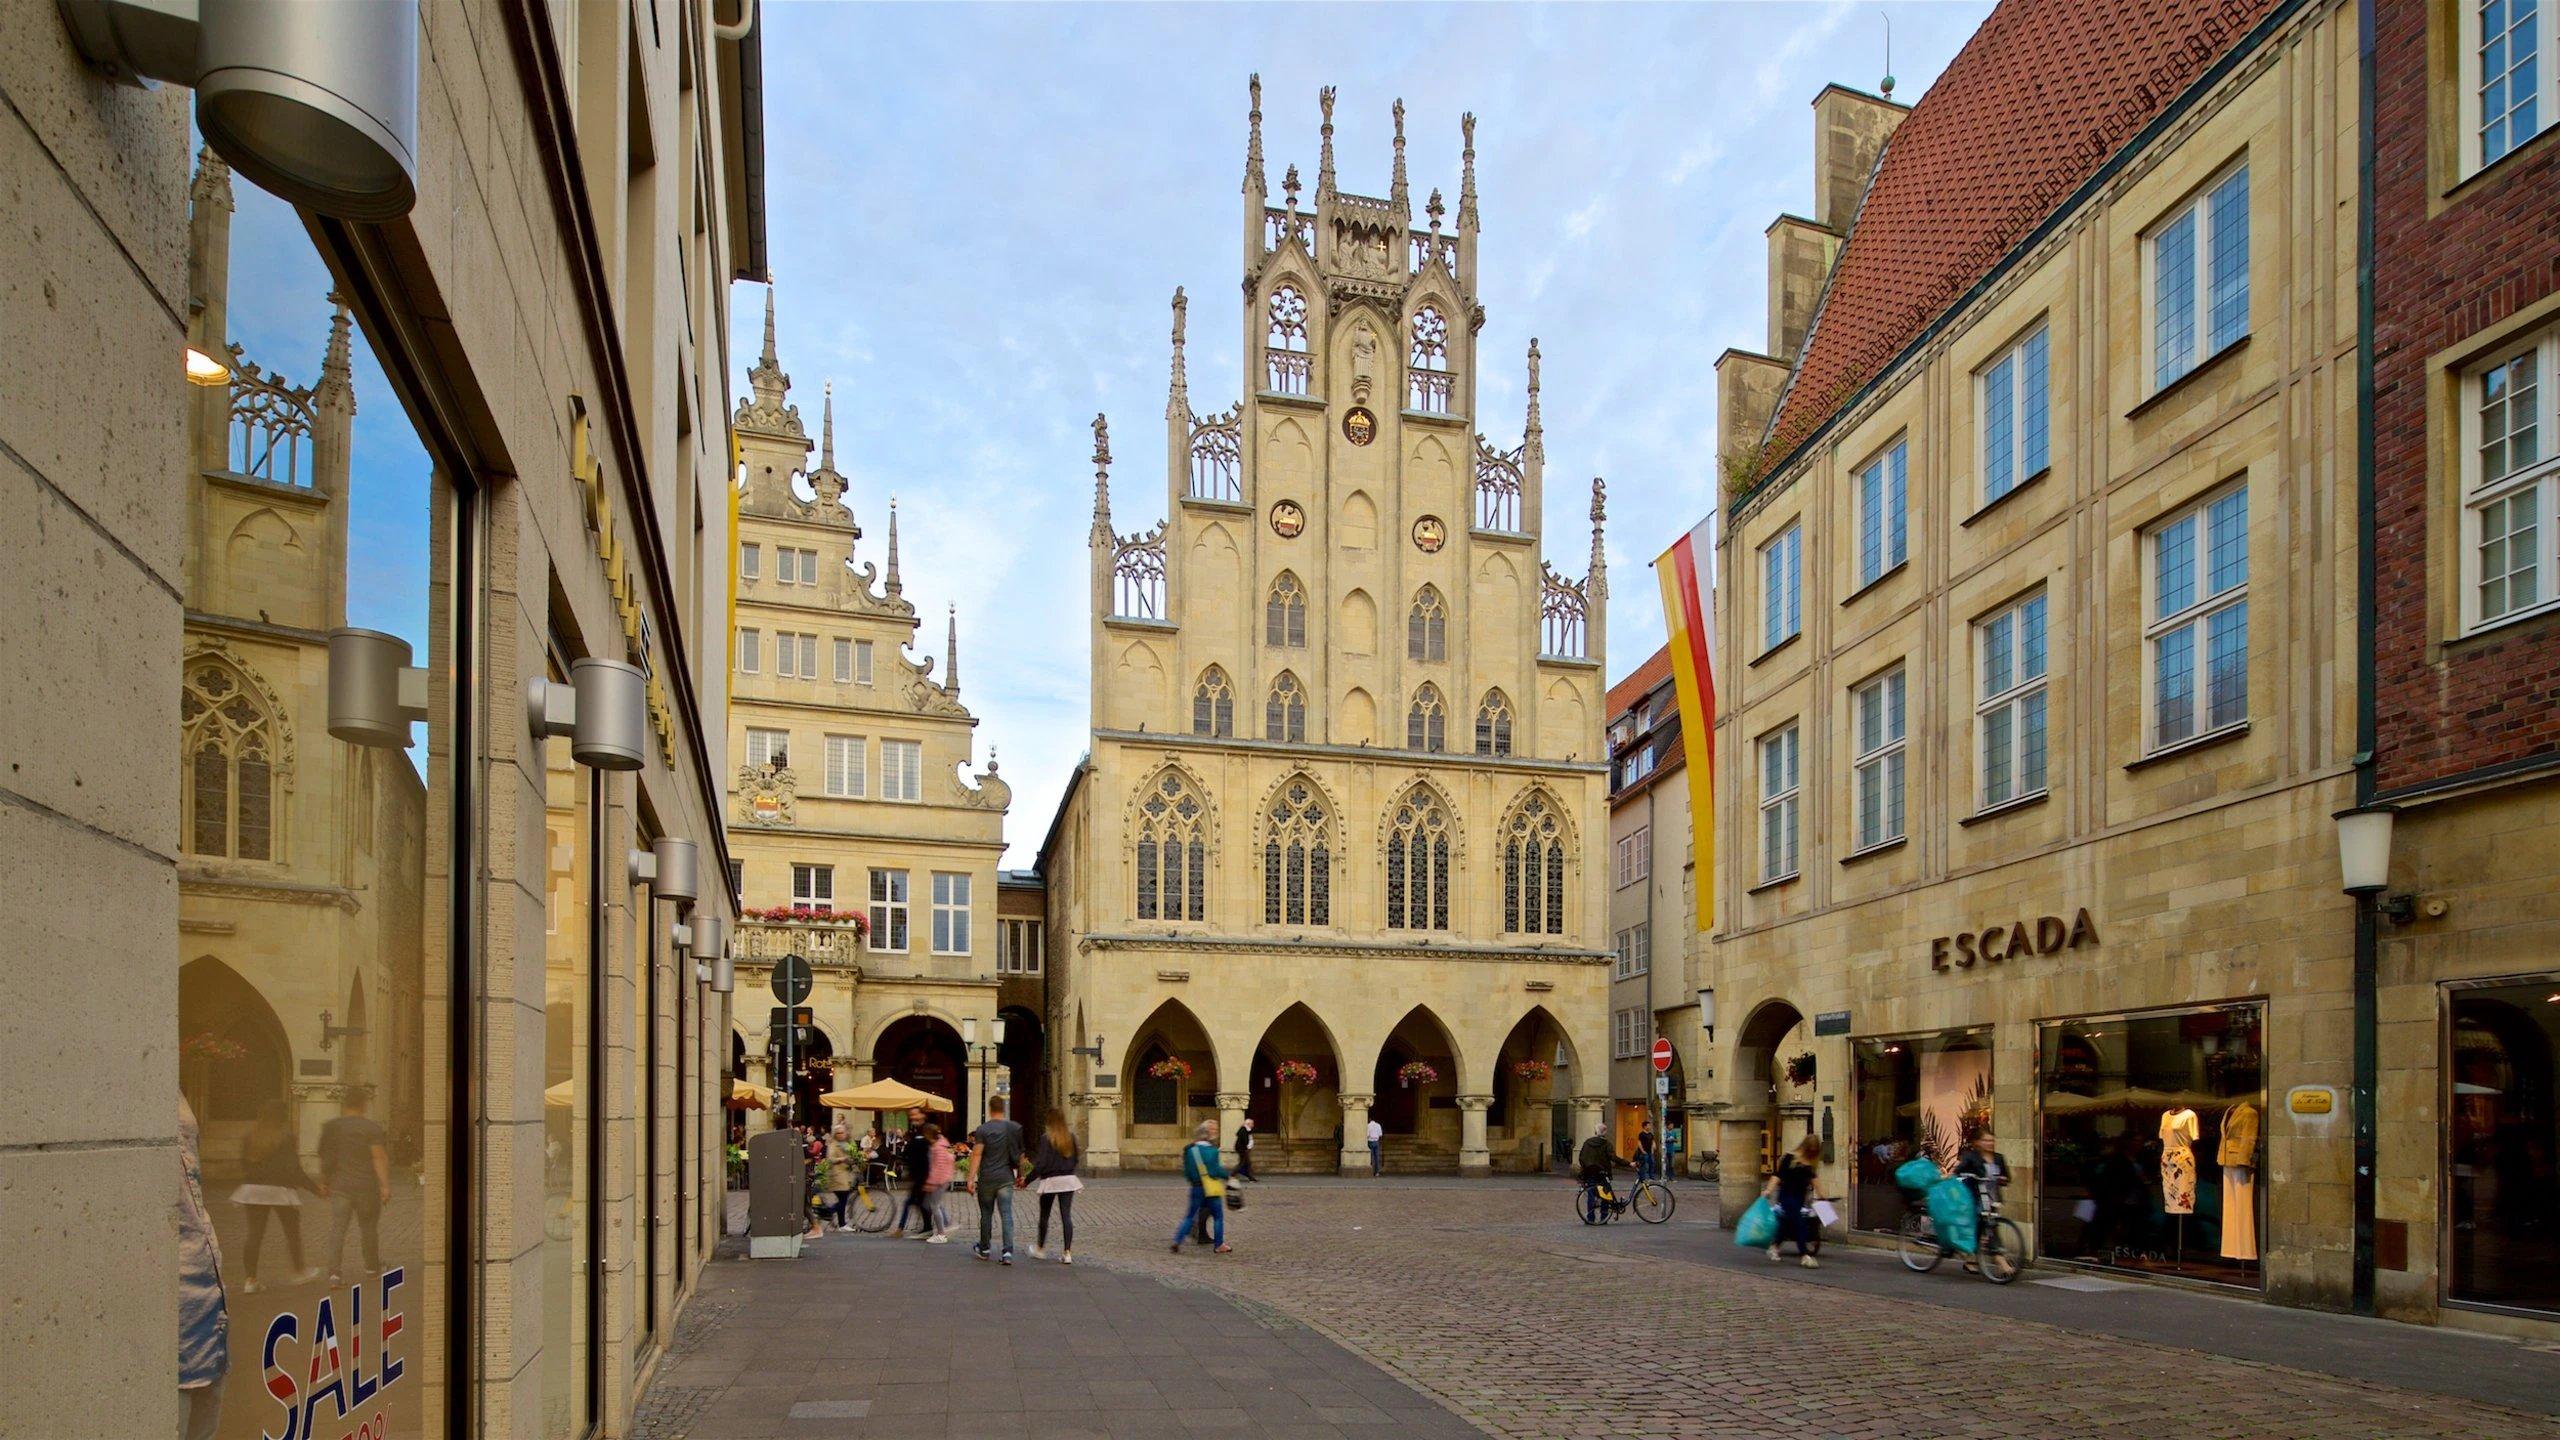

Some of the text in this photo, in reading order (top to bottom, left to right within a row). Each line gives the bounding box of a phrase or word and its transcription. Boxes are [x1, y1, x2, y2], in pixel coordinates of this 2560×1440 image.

[1931, 907, 2101, 971] ESCADA
[2114, 1245, 2167, 1264] ESCADA
[261, 1265, 405, 1440] SALE
